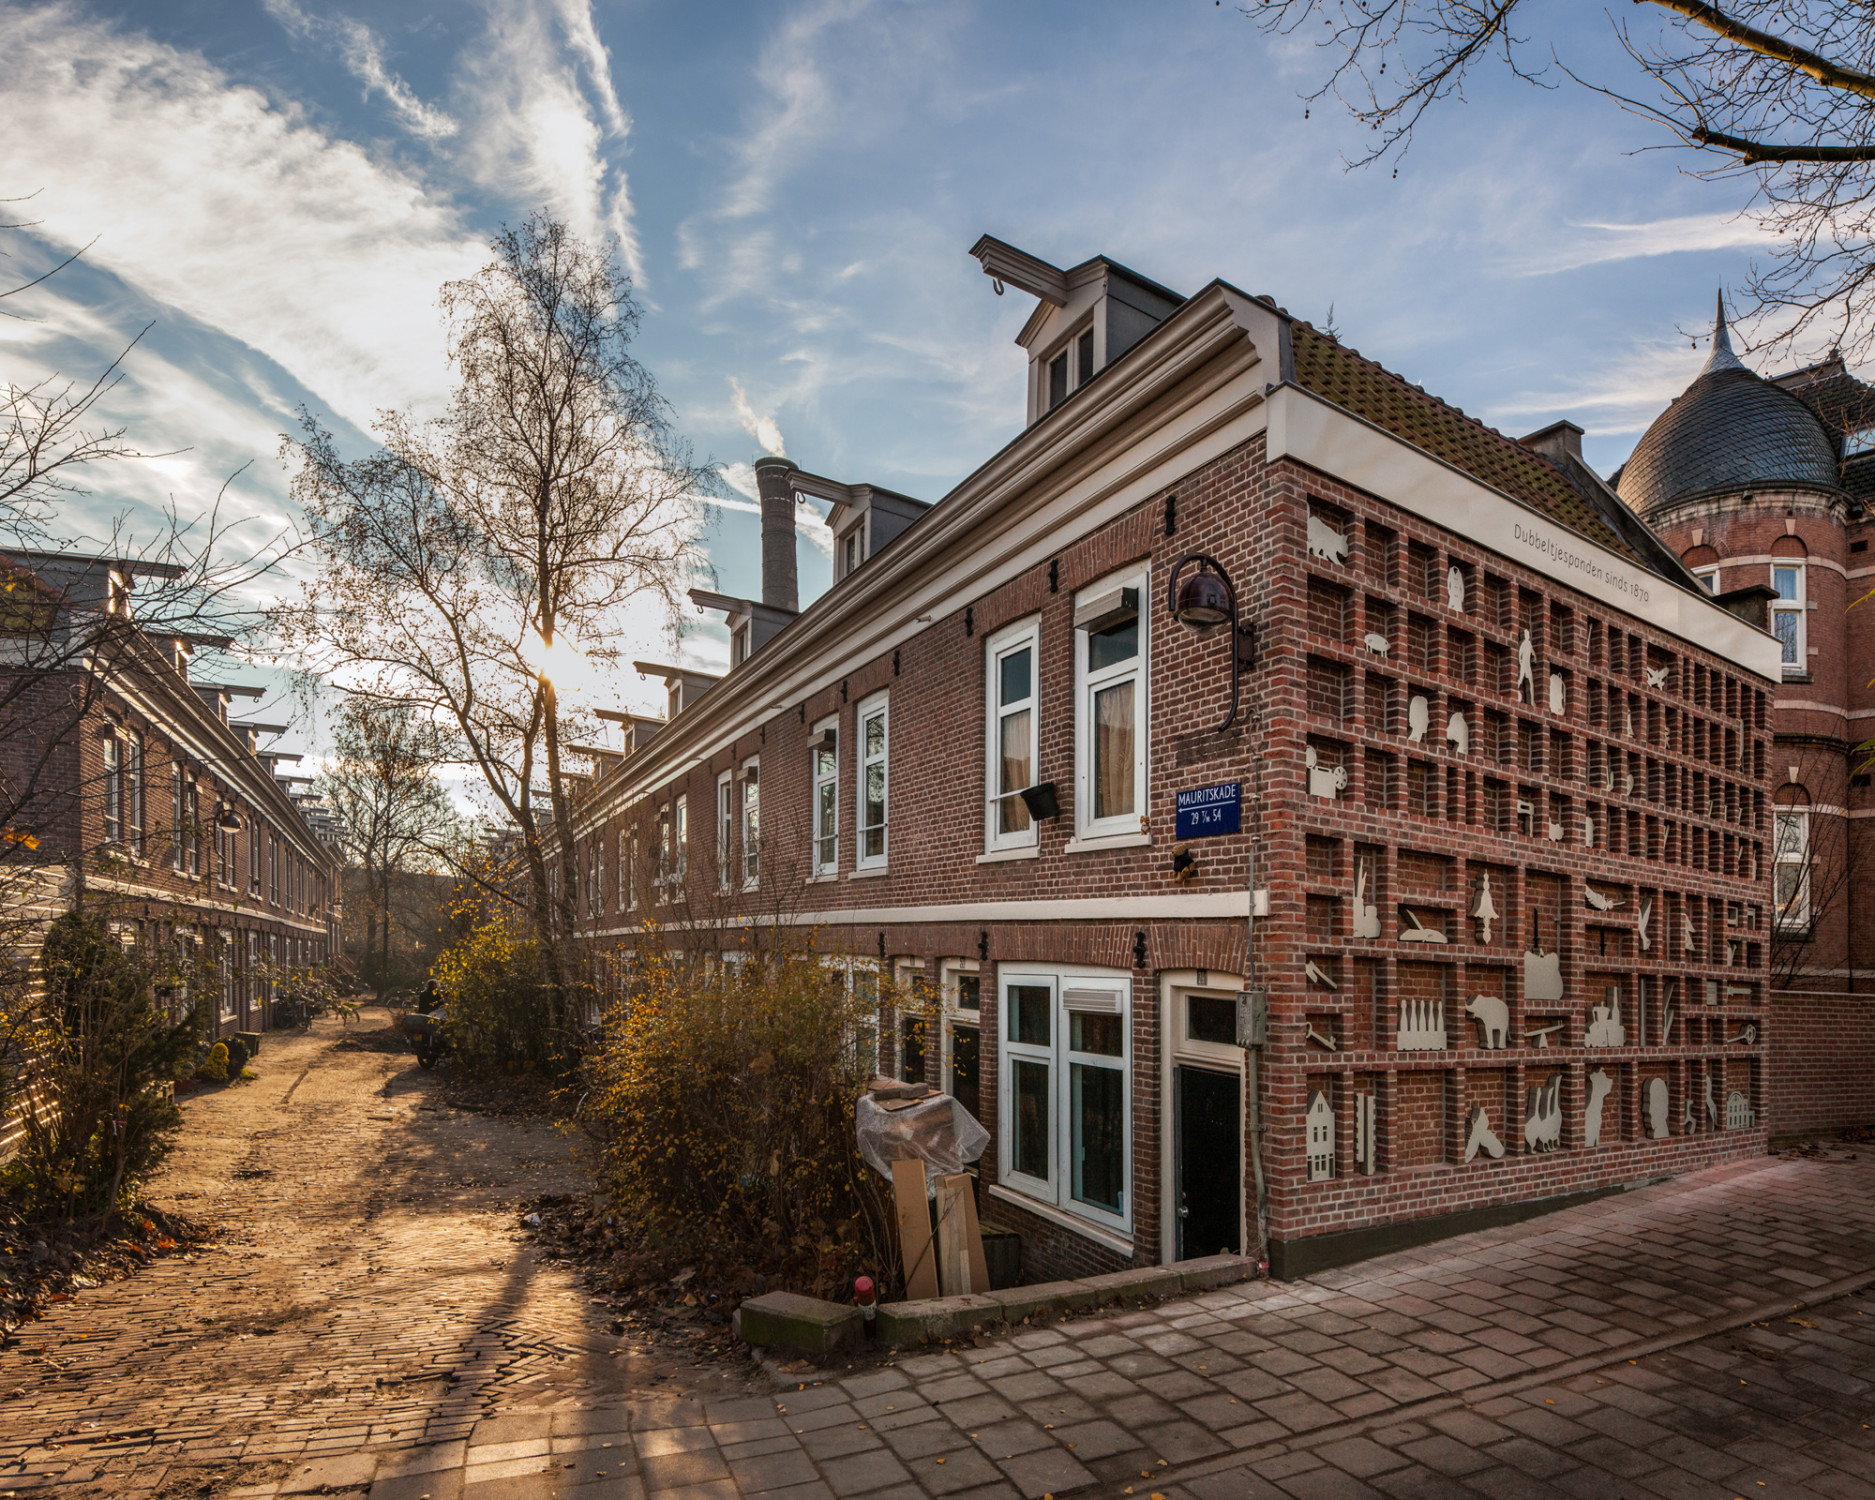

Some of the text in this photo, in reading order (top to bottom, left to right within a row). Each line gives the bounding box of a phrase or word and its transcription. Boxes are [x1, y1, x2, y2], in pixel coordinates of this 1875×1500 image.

[1514, 523, 1649, 602] Dubbeltjespanden sinds 1870
[1178, 784, 1236, 806] MAURITSKADE
[1191, 811, 1199, 825] 29
[1212, 808, 1221, 822] 54
